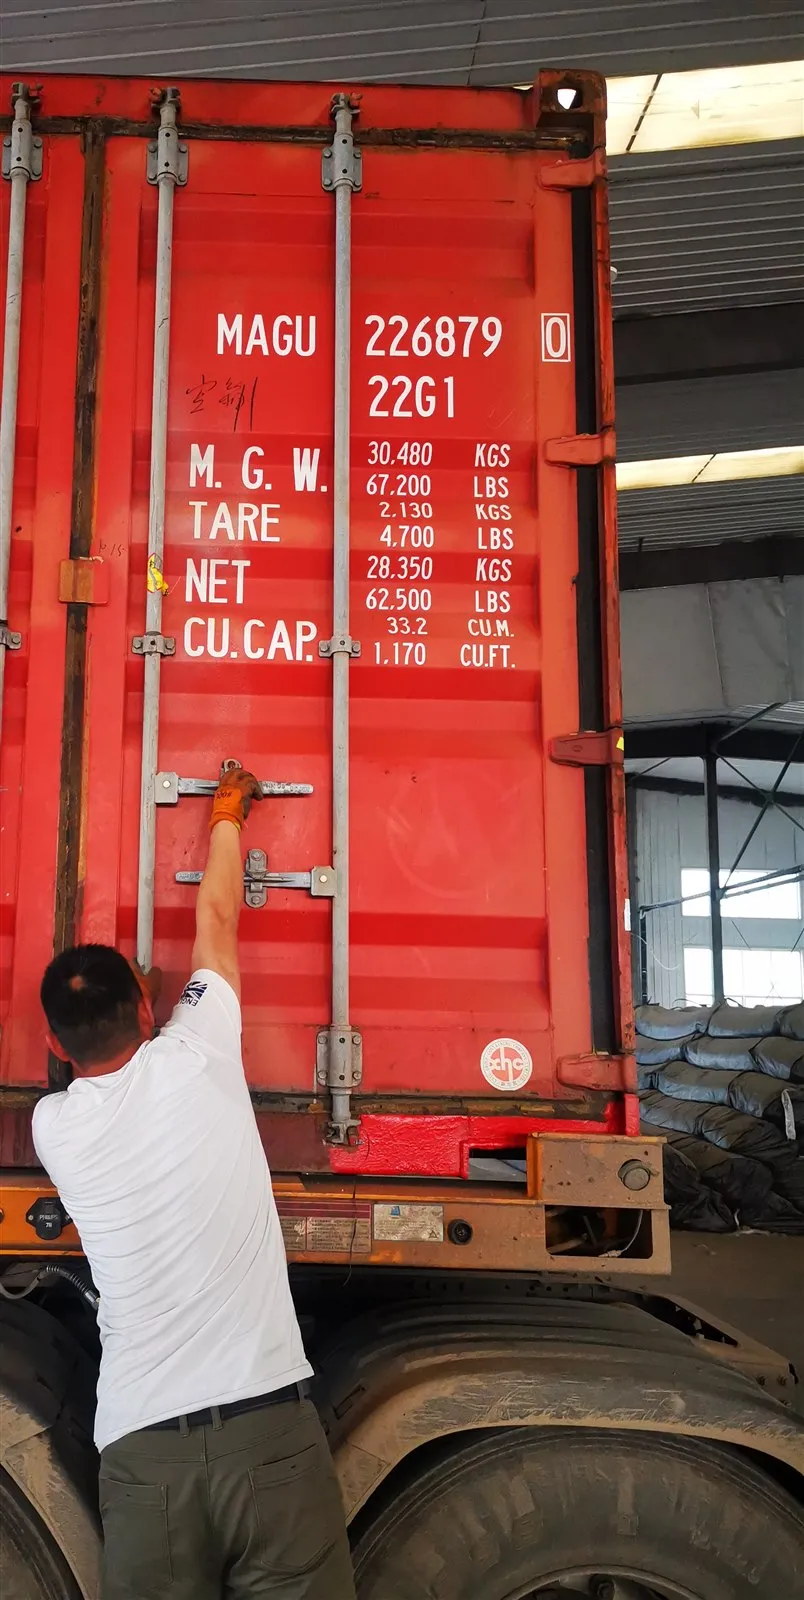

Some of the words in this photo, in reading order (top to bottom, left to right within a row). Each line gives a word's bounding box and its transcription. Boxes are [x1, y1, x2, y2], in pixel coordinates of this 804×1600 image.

[218, 314, 316, 357] MAGU
[365, 315, 502, 357] 226879
[545, 315, 567, 360] 0
[368, 375, 454, 418] 22G1
[189, 444, 222, 488] M.
[241, 446, 272, 491] G.
[293, 448, 328, 492] W.
[368, 441, 433, 466] 30,480
[474, 443, 511, 468] KGS
[366, 474, 431, 497] 67,200
[473, 476, 509, 499] LBS
[189, 501, 281, 543] TARE
[379, 502, 433, 519] 2,130
[475, 504, 512, 521] KGS
[379, 525, 435, 549] 4,700
[477, 527, 514, 551] LBS
[185, 558, 251, 604] NET
[367, 555, 433, 580] 28,350
[475, 558, 512, 582] KGS
[365, 588, 432, 611] 62,500
[475, 590, 511, 613] LBS
[184, 617, 317, 662] CU.CAP.
[386, 617, 428, 635] 33.2
[467, 619, 515, 637] CU.M.
[374, 642, 426, 666] 1,170
[460, 644, 516, 668] CU.FT.
